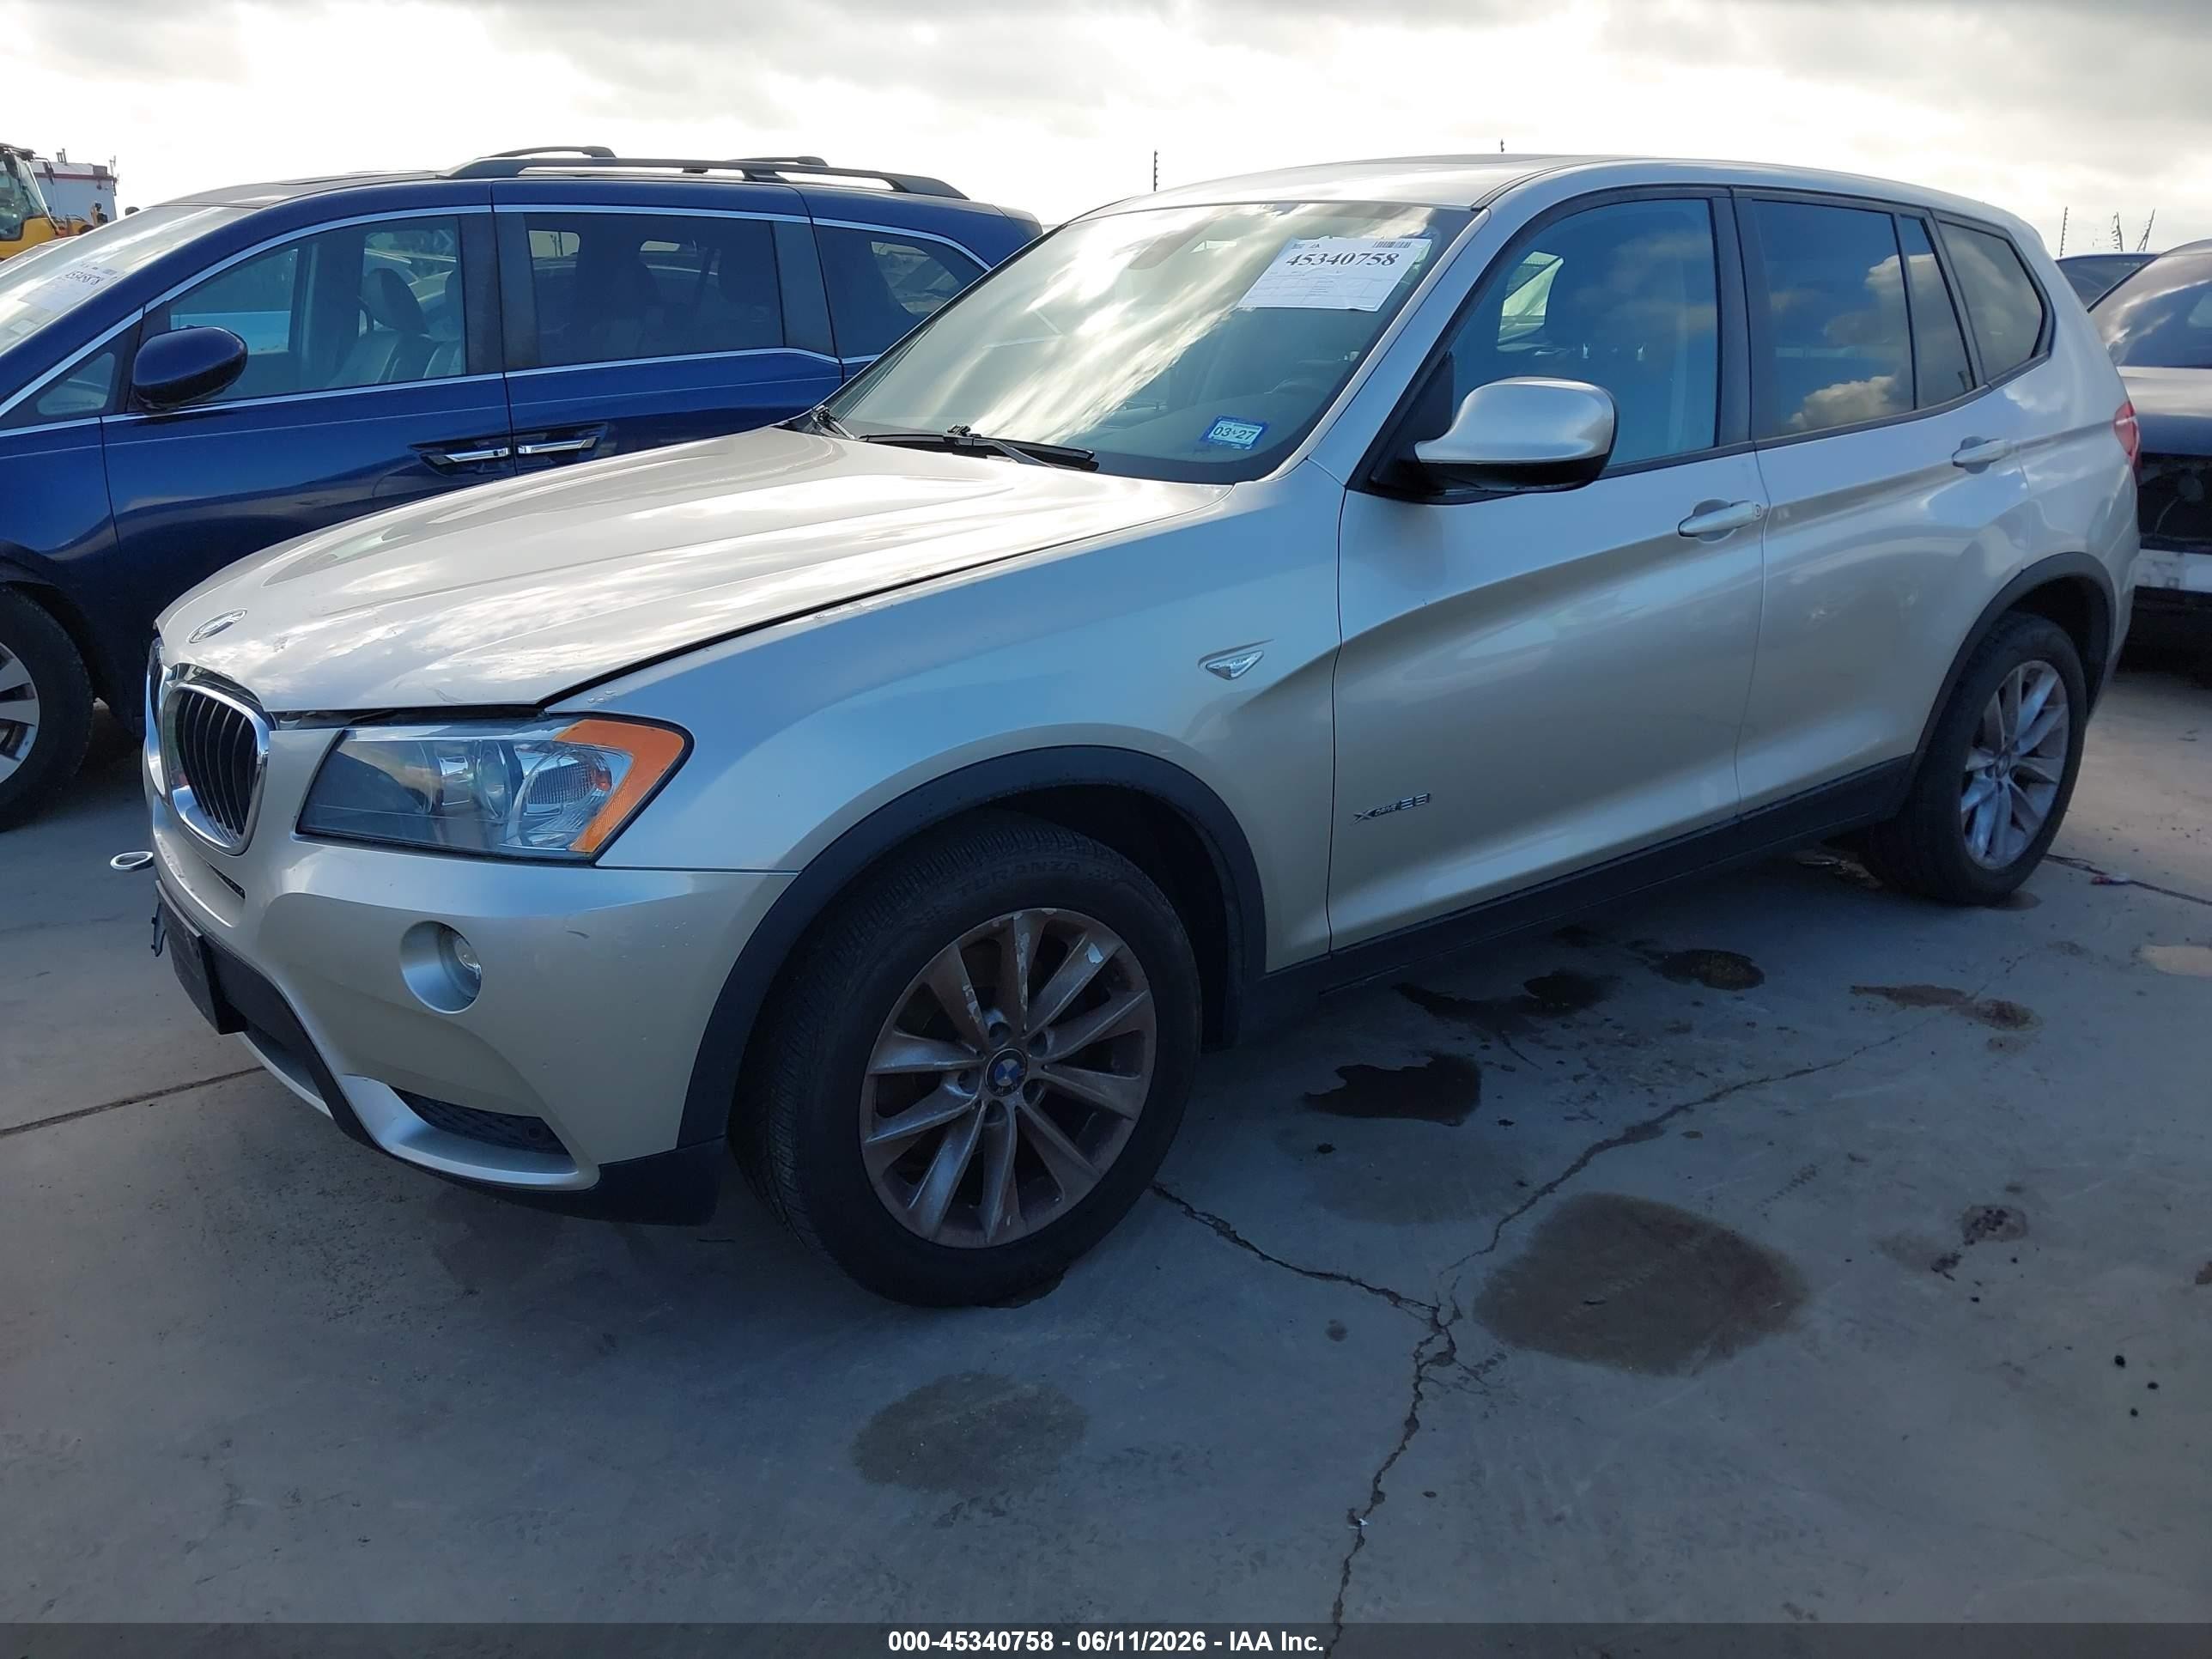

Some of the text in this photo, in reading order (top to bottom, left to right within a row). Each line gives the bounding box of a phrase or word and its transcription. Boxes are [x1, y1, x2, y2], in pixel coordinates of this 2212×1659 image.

[1285, 252, 1401, 266] 45340758
[1212, 426, 1256, 441] 03 27
